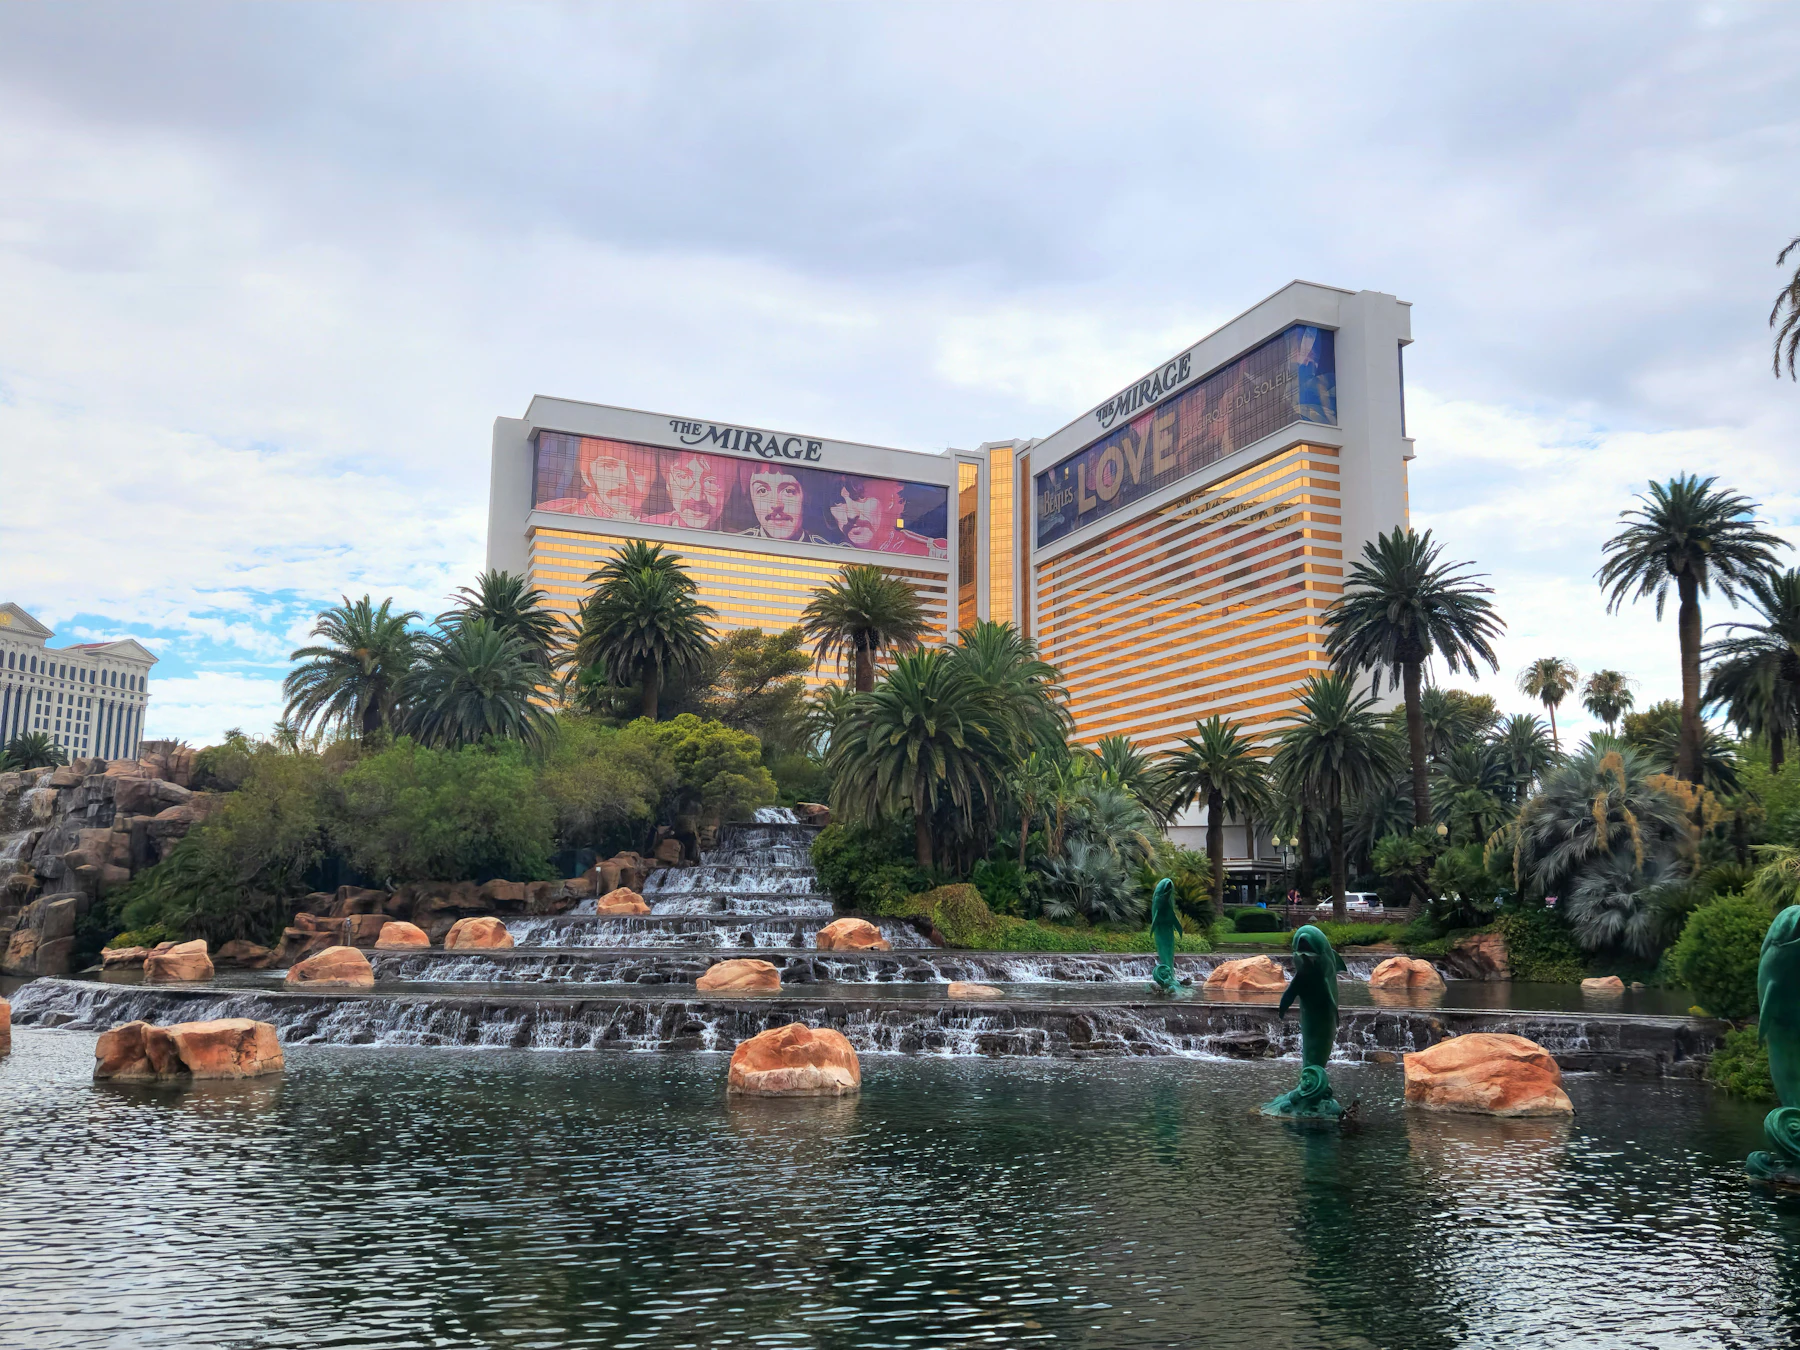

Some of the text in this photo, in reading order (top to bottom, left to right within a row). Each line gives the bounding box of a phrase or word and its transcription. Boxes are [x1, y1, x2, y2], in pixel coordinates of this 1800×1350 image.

[1096, 353, 1191, 428] THE MIRAGE
[1236, 391, 1251, 409] DU
[1254, 370, 1293, 398] SOLEIL
[669, 420, 823, 462] THE MIRAGE
[1077, 411, 1177, 515] LOVE
[1043, 486, 1074, 518] BEATLES
